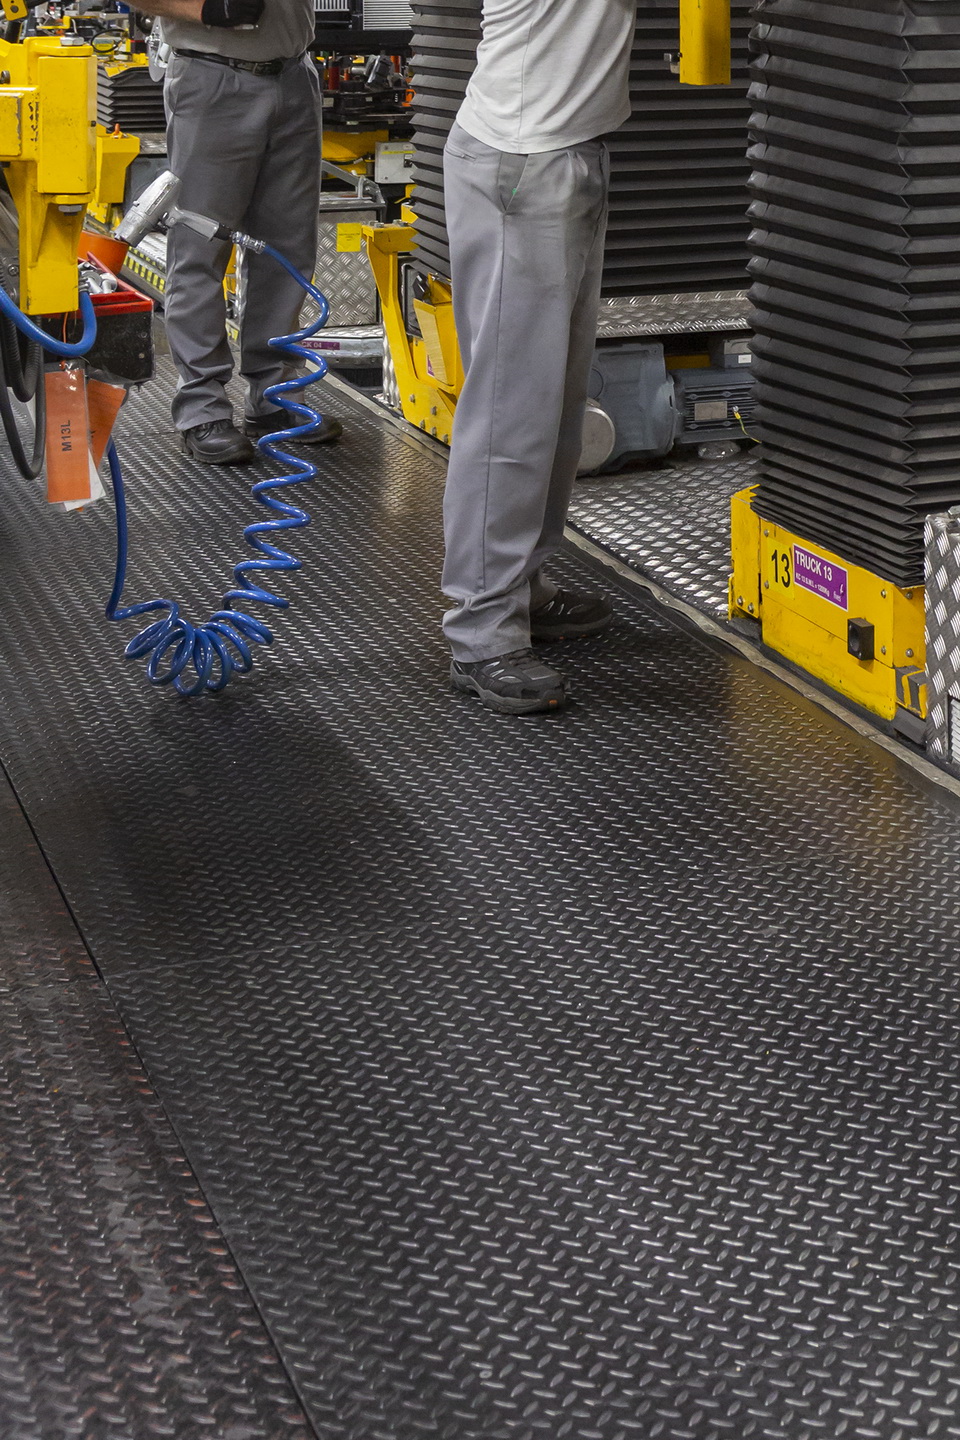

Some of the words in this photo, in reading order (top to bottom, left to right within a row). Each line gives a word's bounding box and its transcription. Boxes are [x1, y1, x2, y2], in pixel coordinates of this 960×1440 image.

[61, 420, 72, 451] M13L
[772, 549, 790, 588] 13
[795, 550, 821, 576] TRUCK
[824, 565, 832, 581] 13
